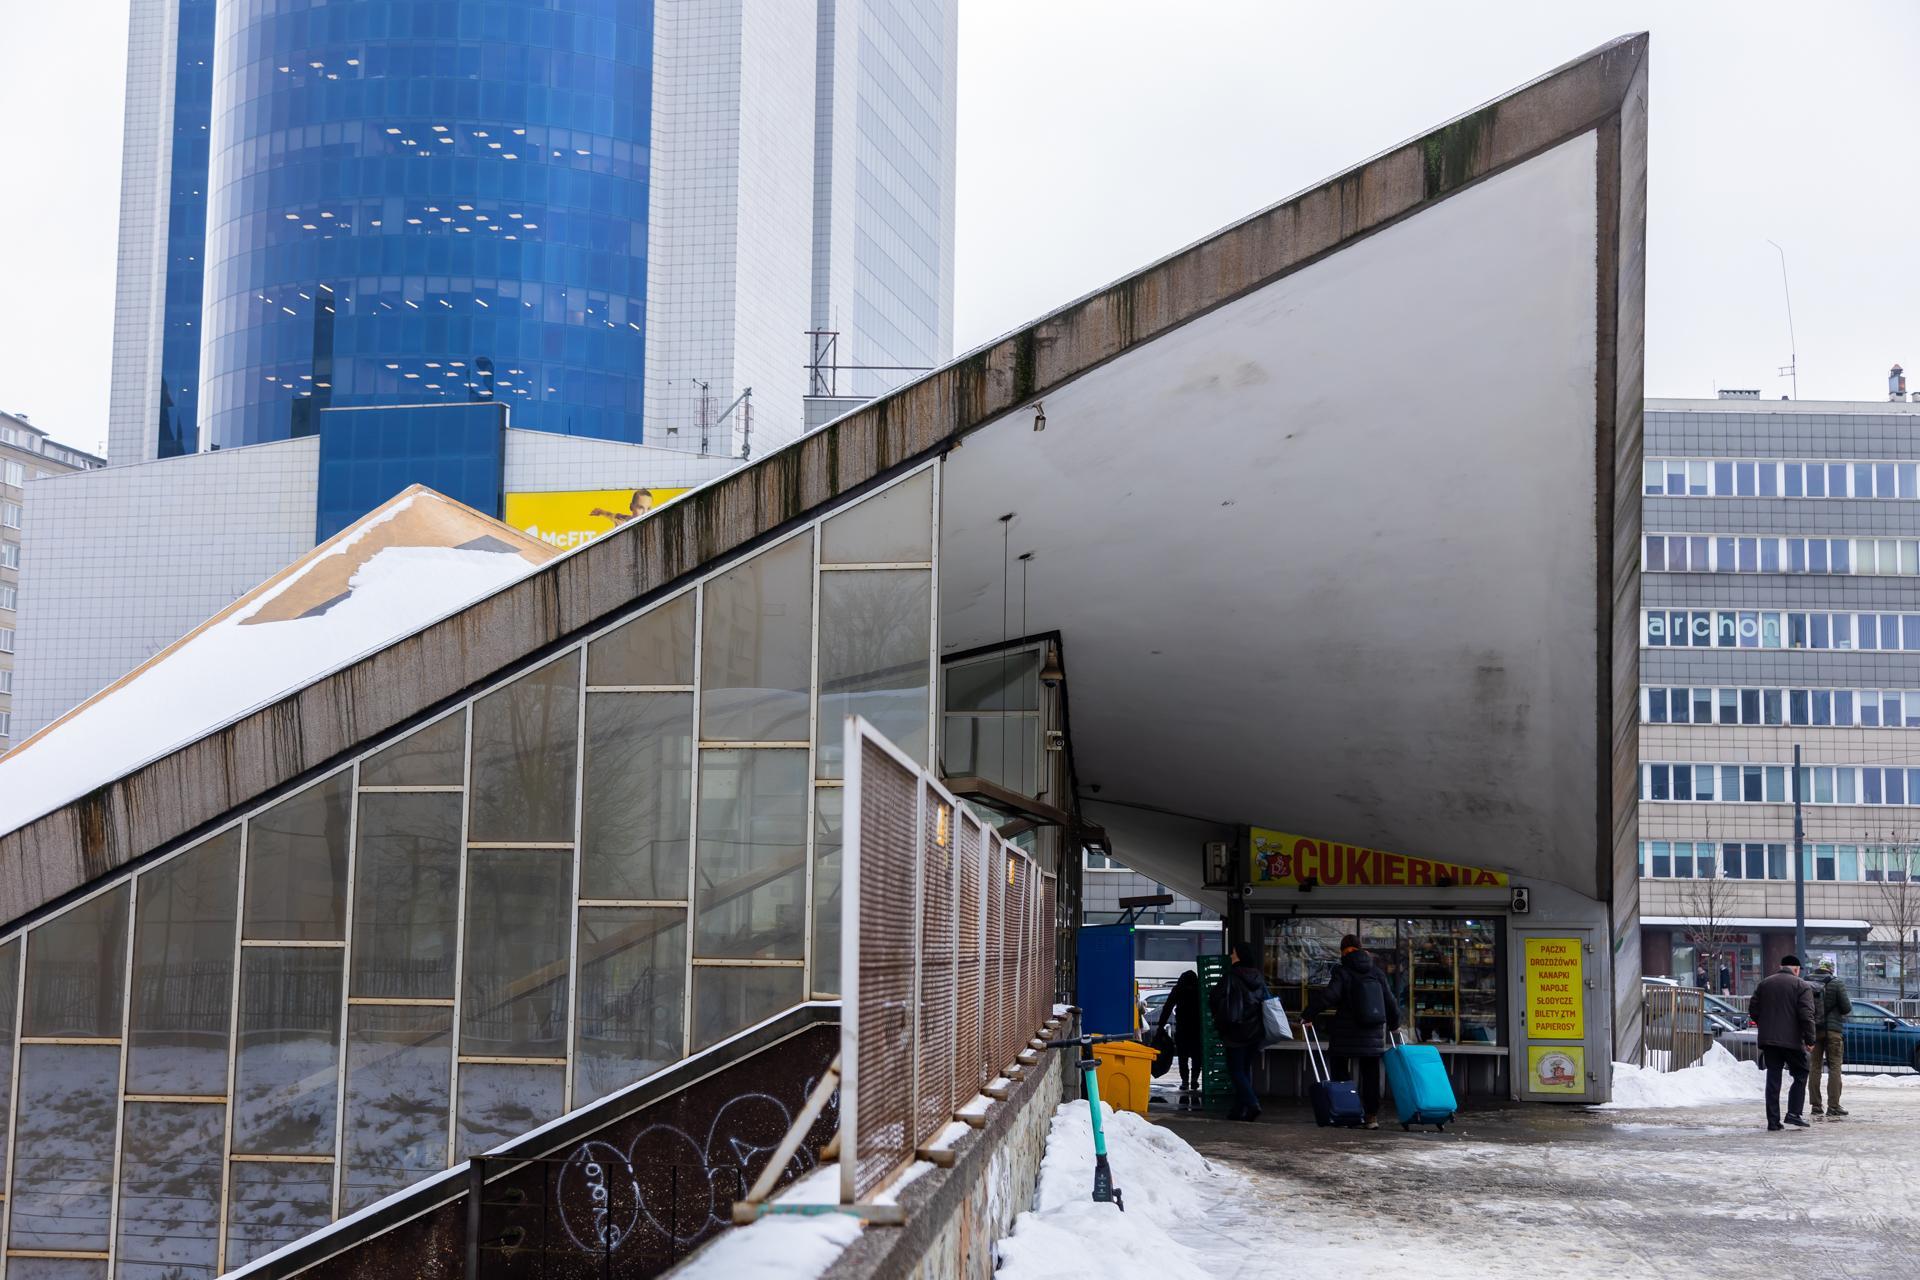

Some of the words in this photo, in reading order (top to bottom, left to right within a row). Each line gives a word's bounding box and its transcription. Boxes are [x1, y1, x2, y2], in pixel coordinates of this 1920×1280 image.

[1648, 615, 1780, 637] archon
[1293, 838, 1499, 886] CUKIERNIA
[1540, 945, 1567, 955] PĄCZKI
[1538, 971, 1570, 979] KANAPKI
[1540, 984, 1568, 992] NAPOJE
[1536, 996, 1573, 1005] SŁODYCZE
[1535, 1009, 1559, 1018] BILETY
[1561, 1009, 1576, 1018] ZTM
[1536, 1022, 1576, 1031] PAPIEROSY
